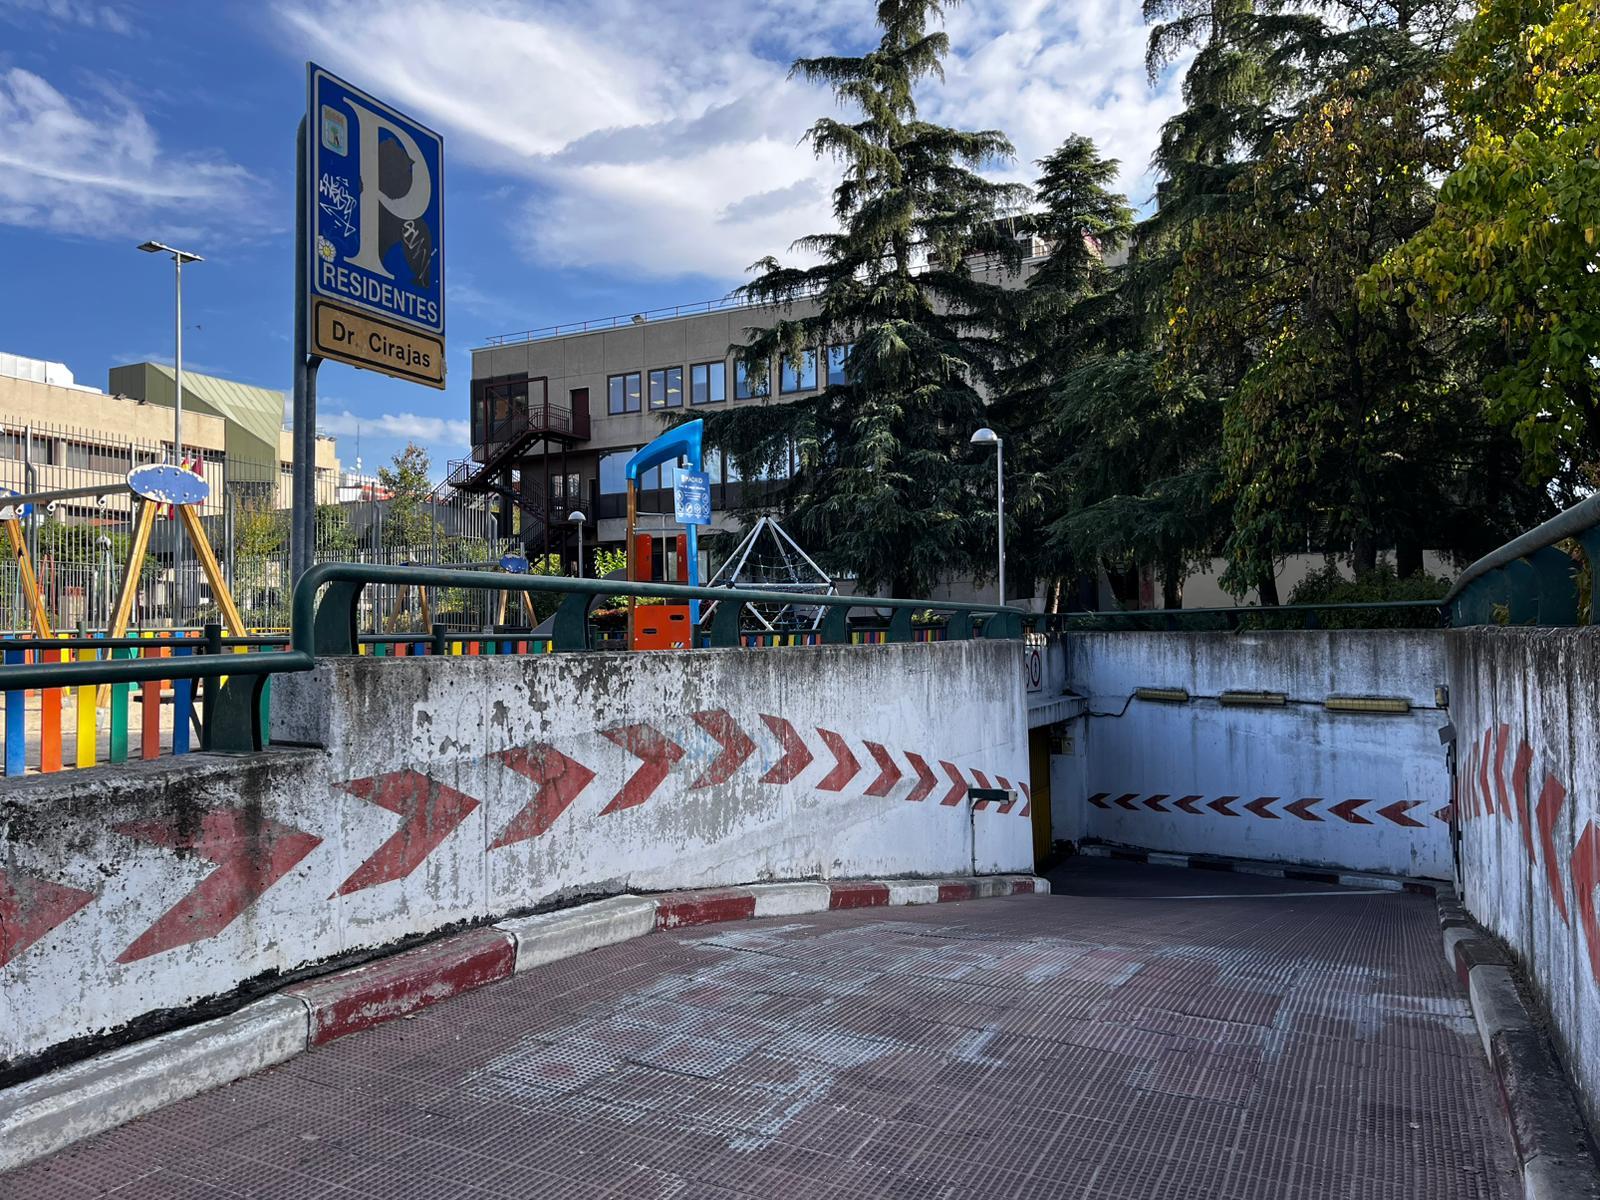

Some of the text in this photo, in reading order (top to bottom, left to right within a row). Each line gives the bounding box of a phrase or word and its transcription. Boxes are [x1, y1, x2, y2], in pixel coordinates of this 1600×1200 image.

[343, 97, 431, 280] P
[323, 262, 438, 323] RESIDENTES
[369, 333, 431, 368] Cirajas
